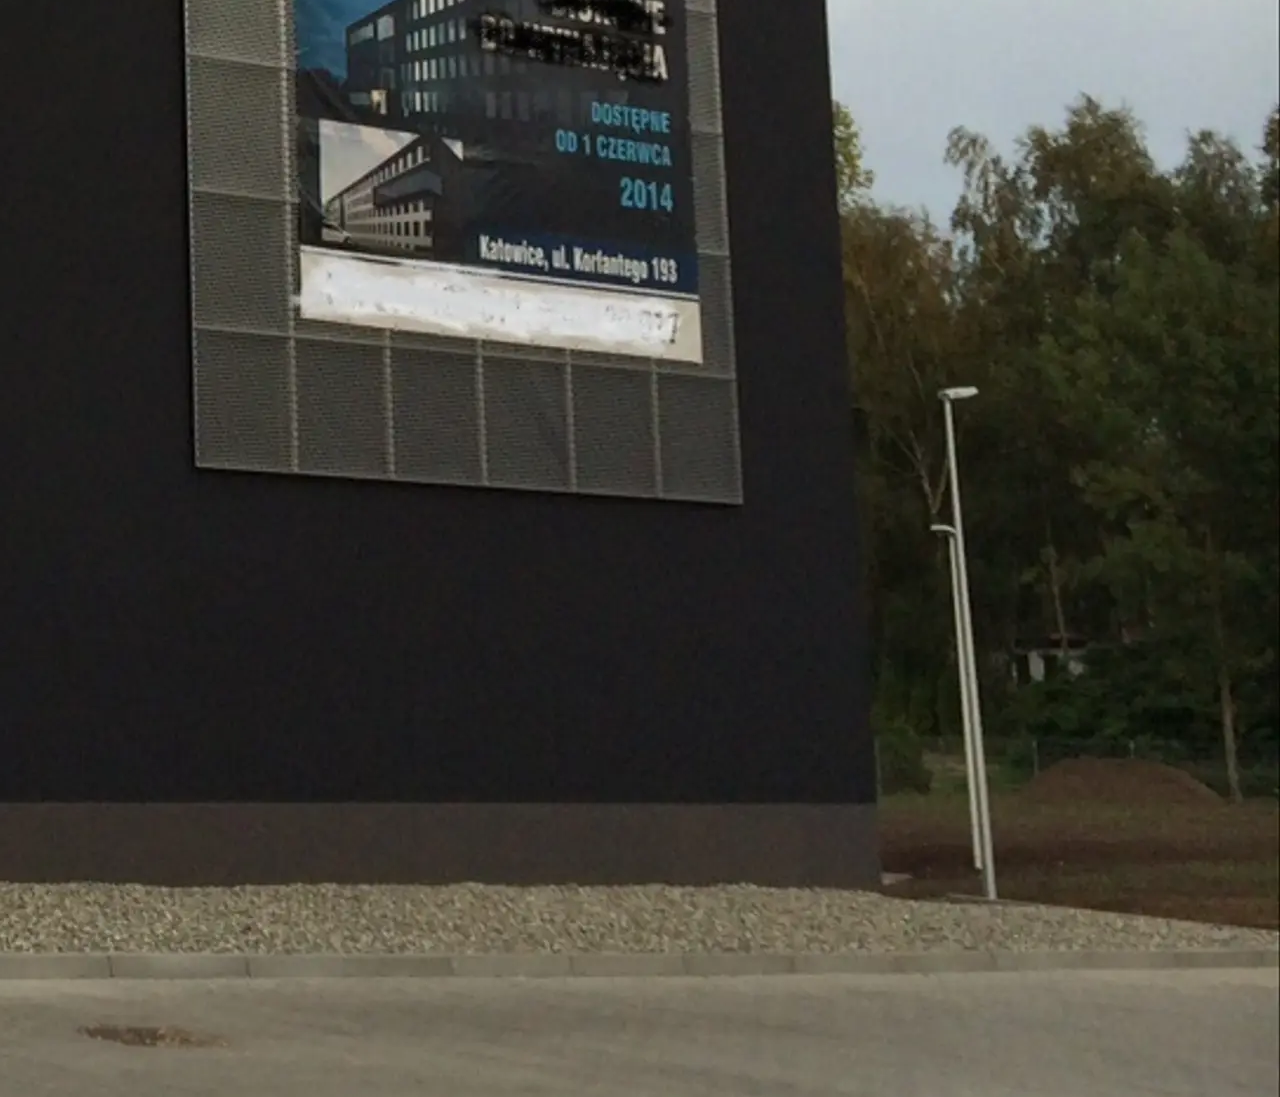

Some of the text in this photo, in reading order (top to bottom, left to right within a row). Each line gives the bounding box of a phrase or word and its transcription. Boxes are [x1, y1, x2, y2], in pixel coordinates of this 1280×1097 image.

[591, 101, 671, 134] DOSTĘPNE
[555, 128, 672, 166] OD 1 CZERWCA
[620, 176, 673, 212] 2014
[479, 234, 678, 284] Katowice, ul. Korfantego 193
